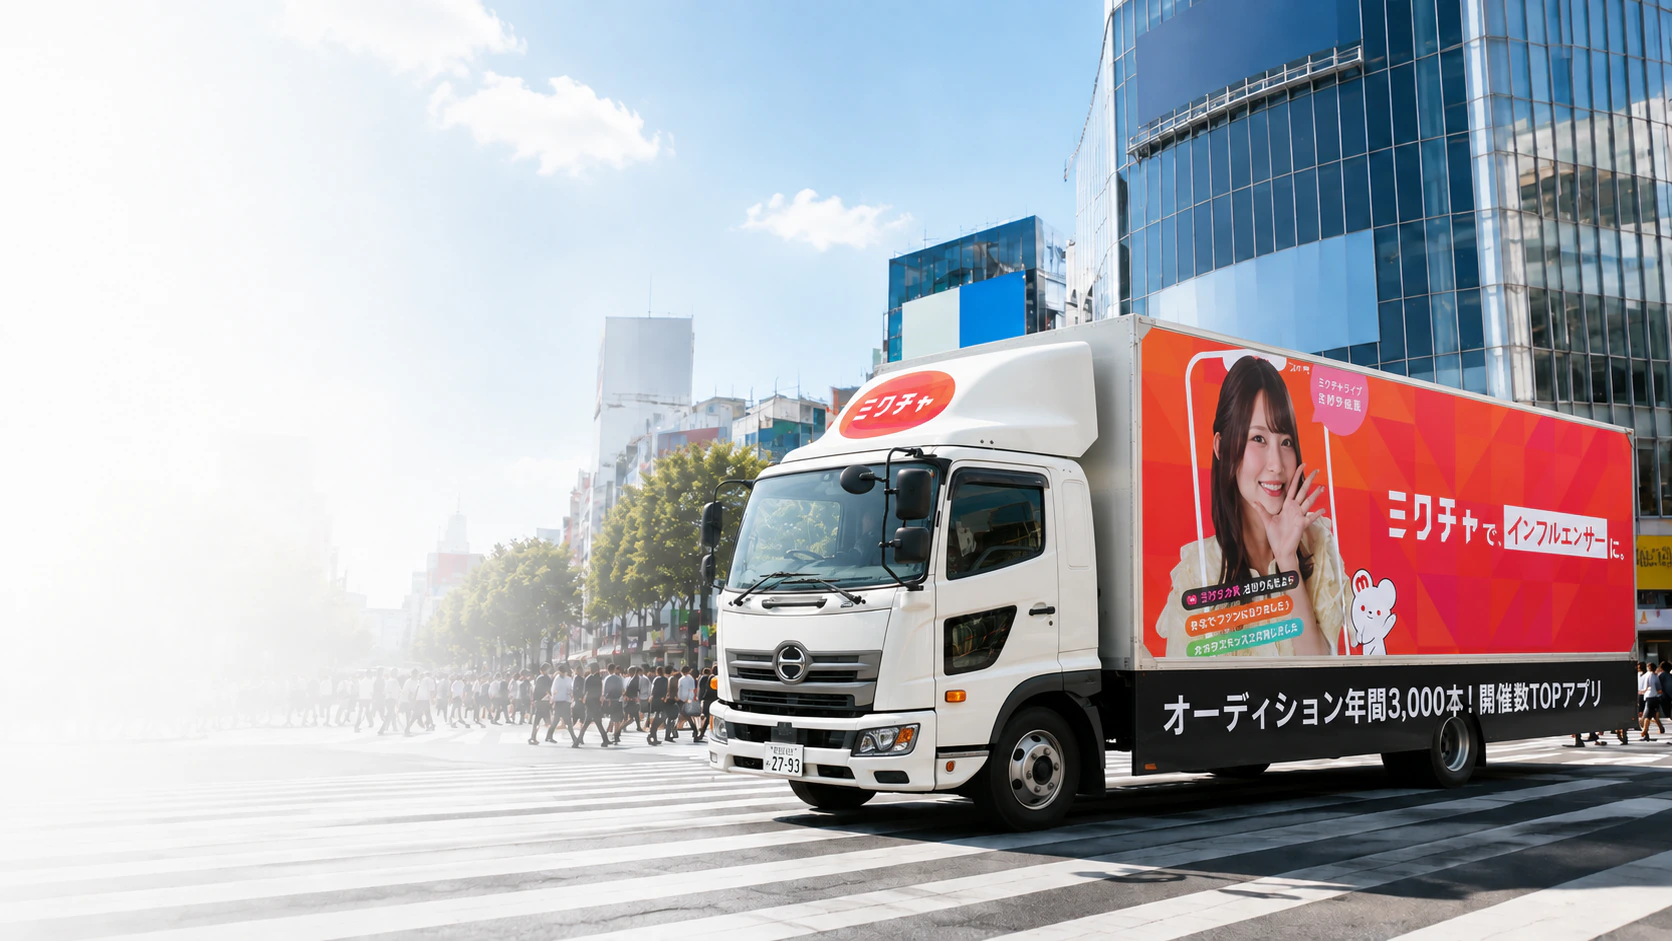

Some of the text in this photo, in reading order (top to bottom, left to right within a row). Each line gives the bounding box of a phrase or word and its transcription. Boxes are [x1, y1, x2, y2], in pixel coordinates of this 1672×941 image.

[852, 392, 935, 422] ミクチャ
[771, 755, 800, 773] 27-93
